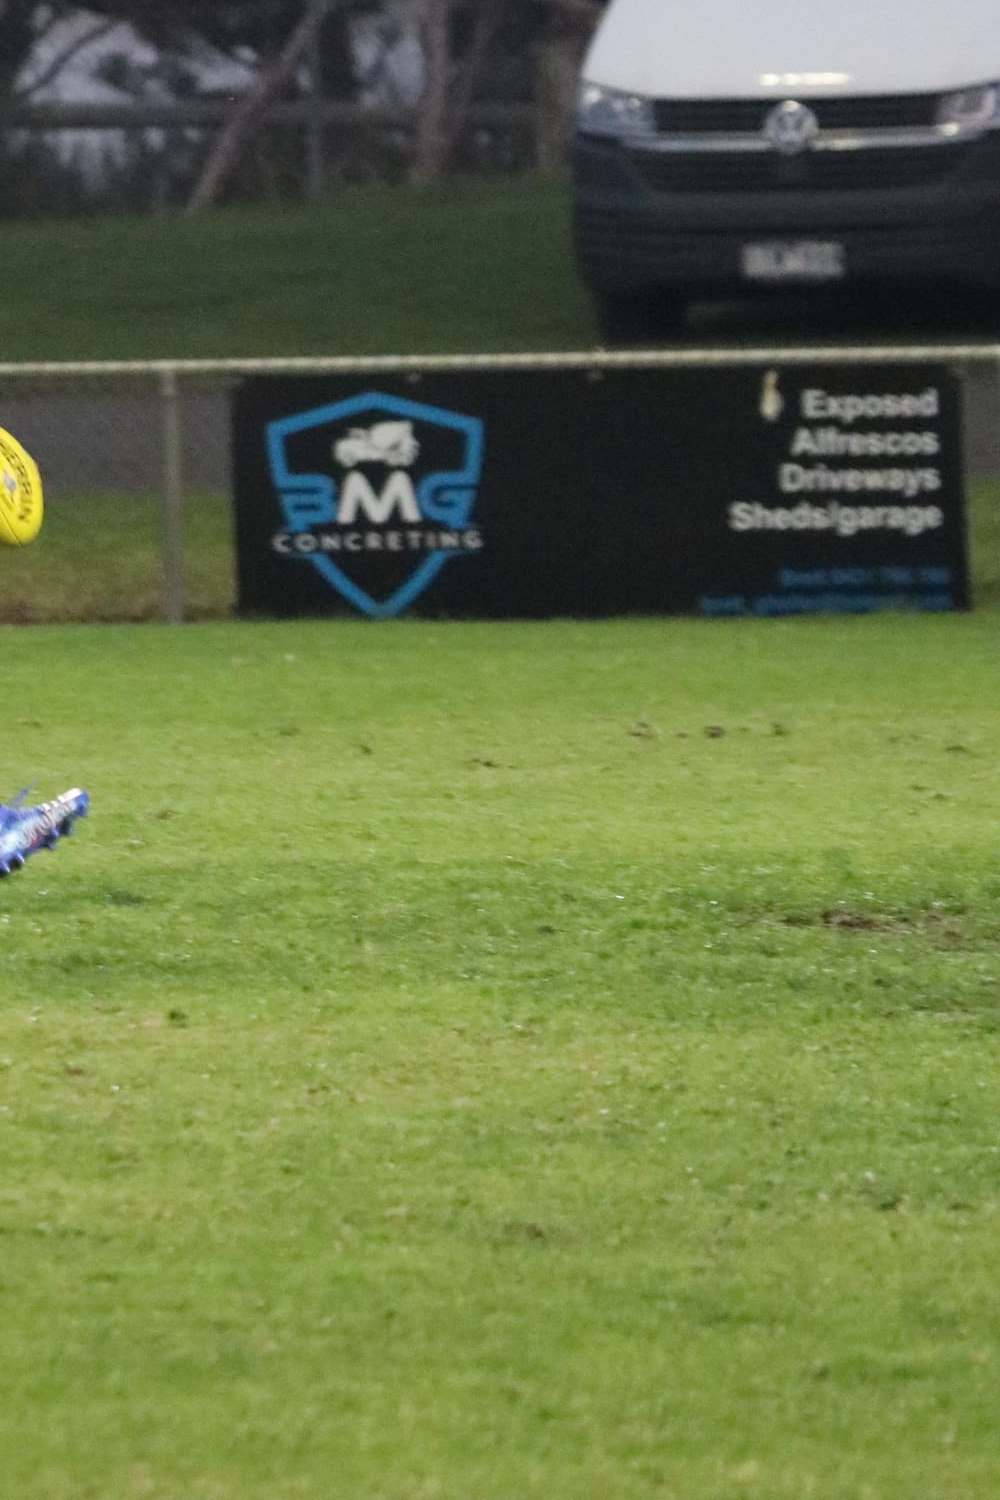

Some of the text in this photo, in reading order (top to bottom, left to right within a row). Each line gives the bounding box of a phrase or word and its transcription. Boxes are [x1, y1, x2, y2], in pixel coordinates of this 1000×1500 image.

[802, 388, 940, 422] Exposed
[791, 427, 941, 456] Alfrescos
[779, 463, 942, 497] Driveways
[272, 530, 483, 553] CONCRETING
